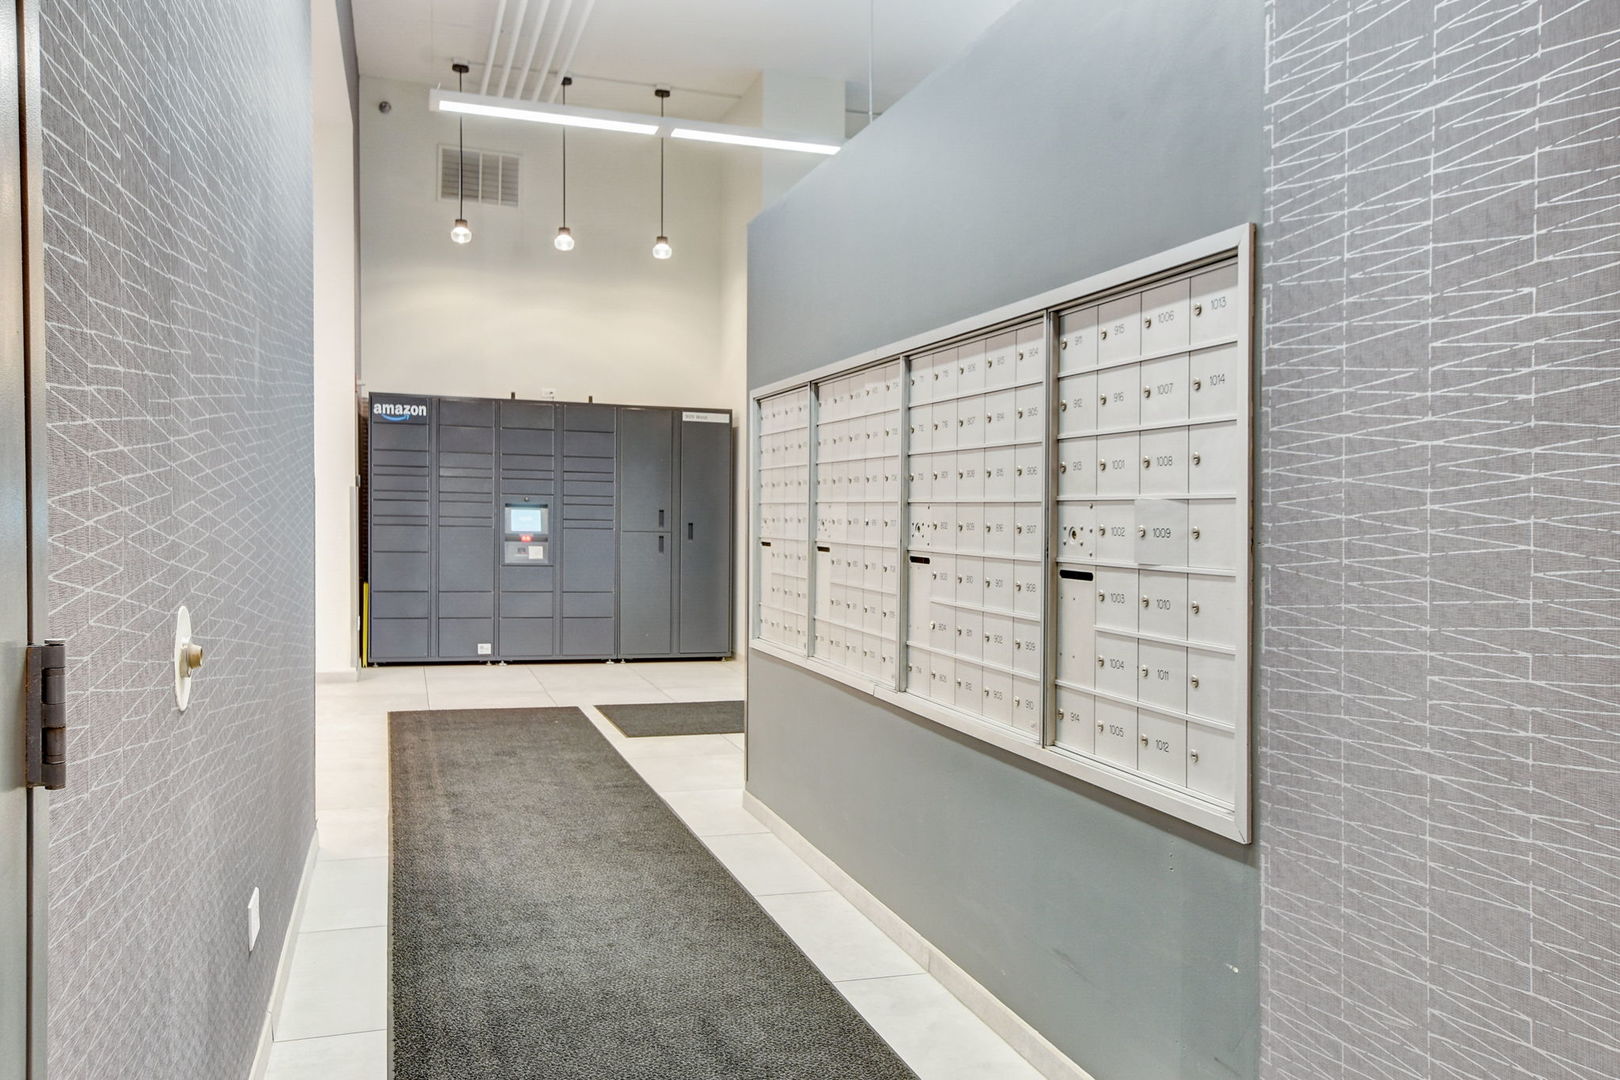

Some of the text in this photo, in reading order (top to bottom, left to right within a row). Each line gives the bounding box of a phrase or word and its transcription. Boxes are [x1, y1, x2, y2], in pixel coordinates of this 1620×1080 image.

[1211, 296, 1227, 310] 1013
[1158, 310, 1174, 323] 1006
[1114, 323, 1125, 336] 915
[1210, 373, 1225, 386] 1014
[1157, 382, 1174, 395] 1007
[1073, 398, 1083, 408] 912
[1113, 392, 1124, 402] 916
[373, 403, 427, 417] amazon
[1112, 459, 1125, 470] 1001
[1156, 456, 1173, 466] 1008
[1111, 527, 1125, 538] 1002
[1153, 528, 1171, 538] 1009
[1111, 593, 1125, 604] 1003
[1156, 599, 1171, 610] 1010
[1110, 658, 1124, 670] 1004
[1157, 669, 1169, 681] 1011
[1070, 712, 1080, 722] 914
[1109, 723, 1124, 738] 1005
[1156, 739, 1169, 752] 1012
